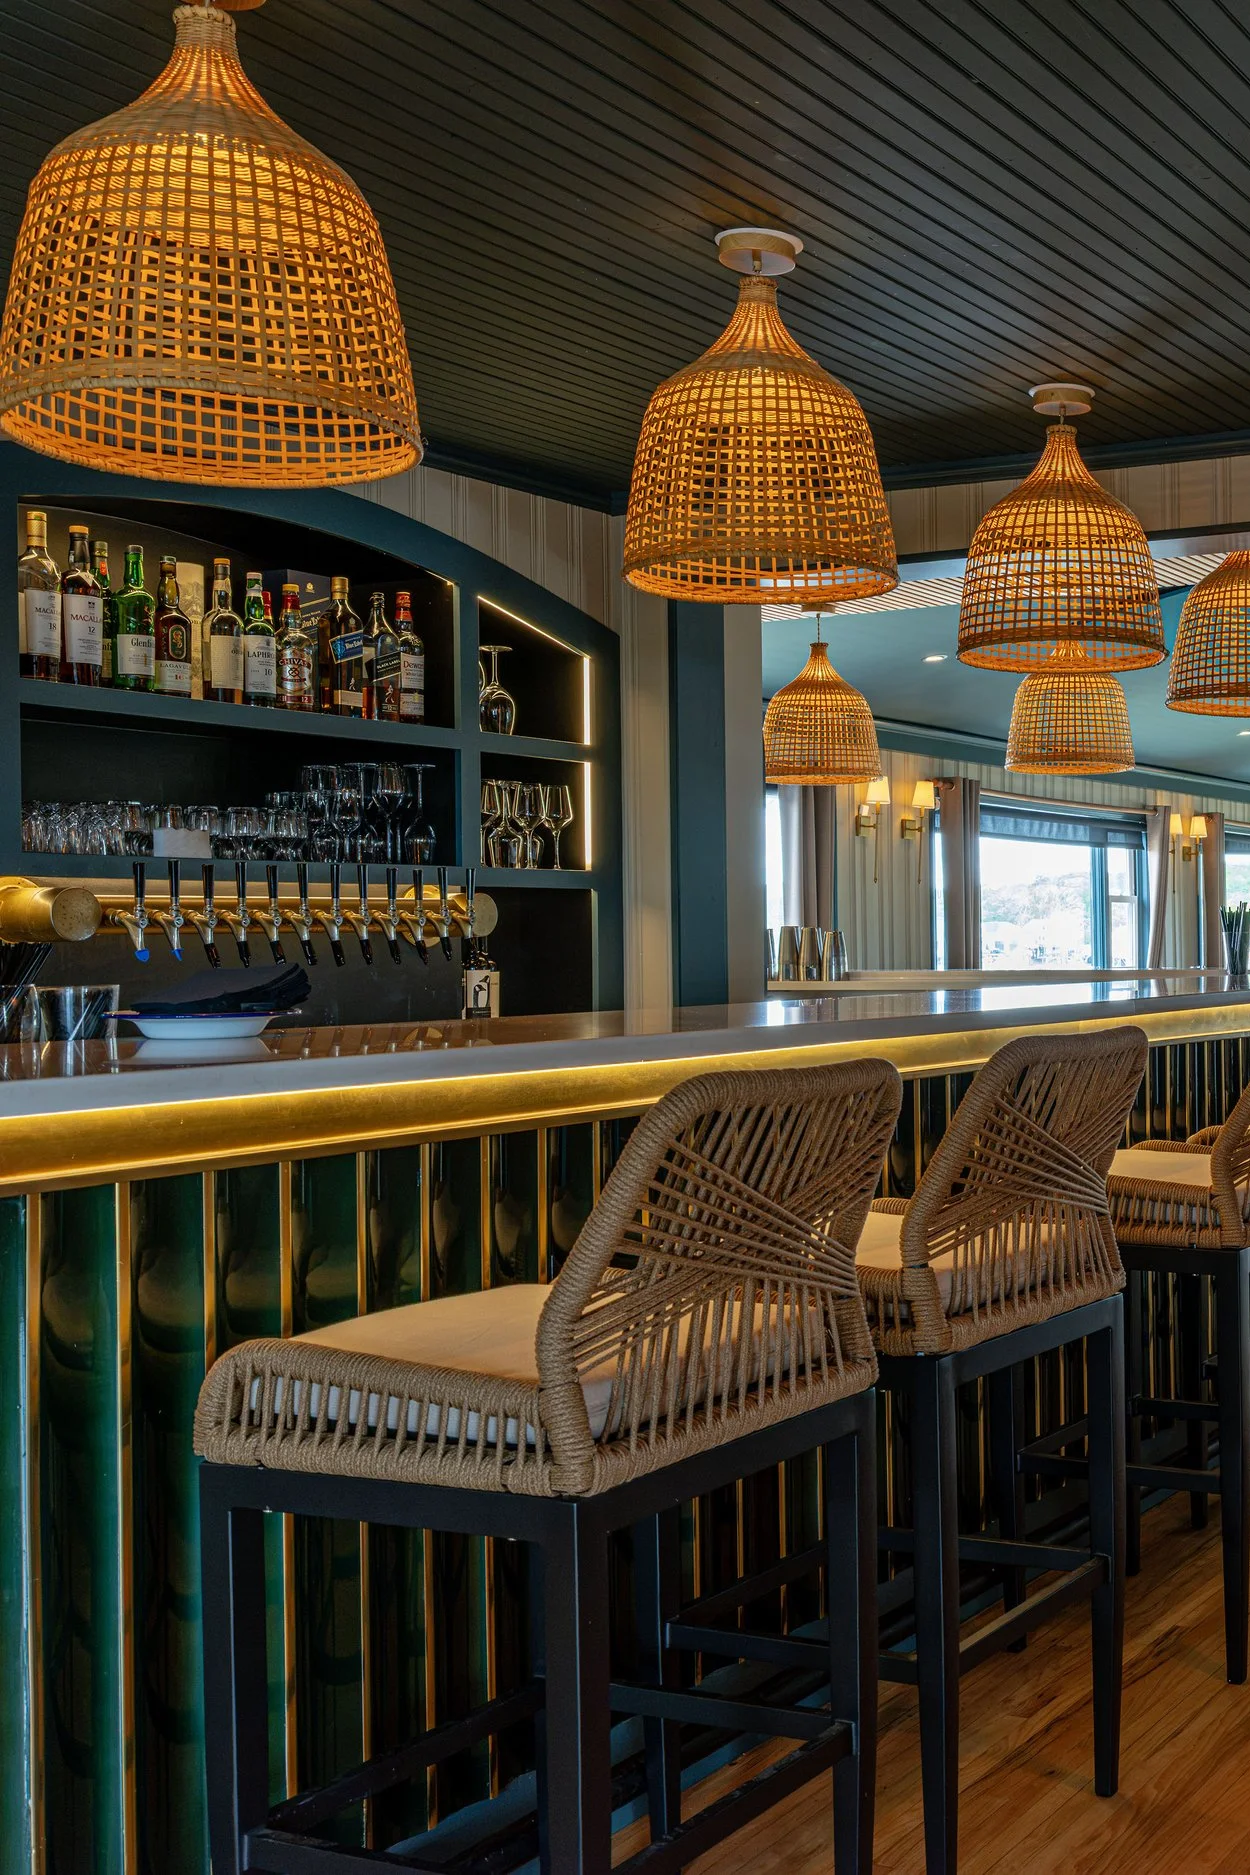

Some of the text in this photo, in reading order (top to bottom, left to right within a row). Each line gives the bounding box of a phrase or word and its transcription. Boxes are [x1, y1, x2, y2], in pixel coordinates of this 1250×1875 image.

[48, 622, 57, 631] 18
[88, 626, 96, 634] 12
[264, 668, 273, 676] 10
